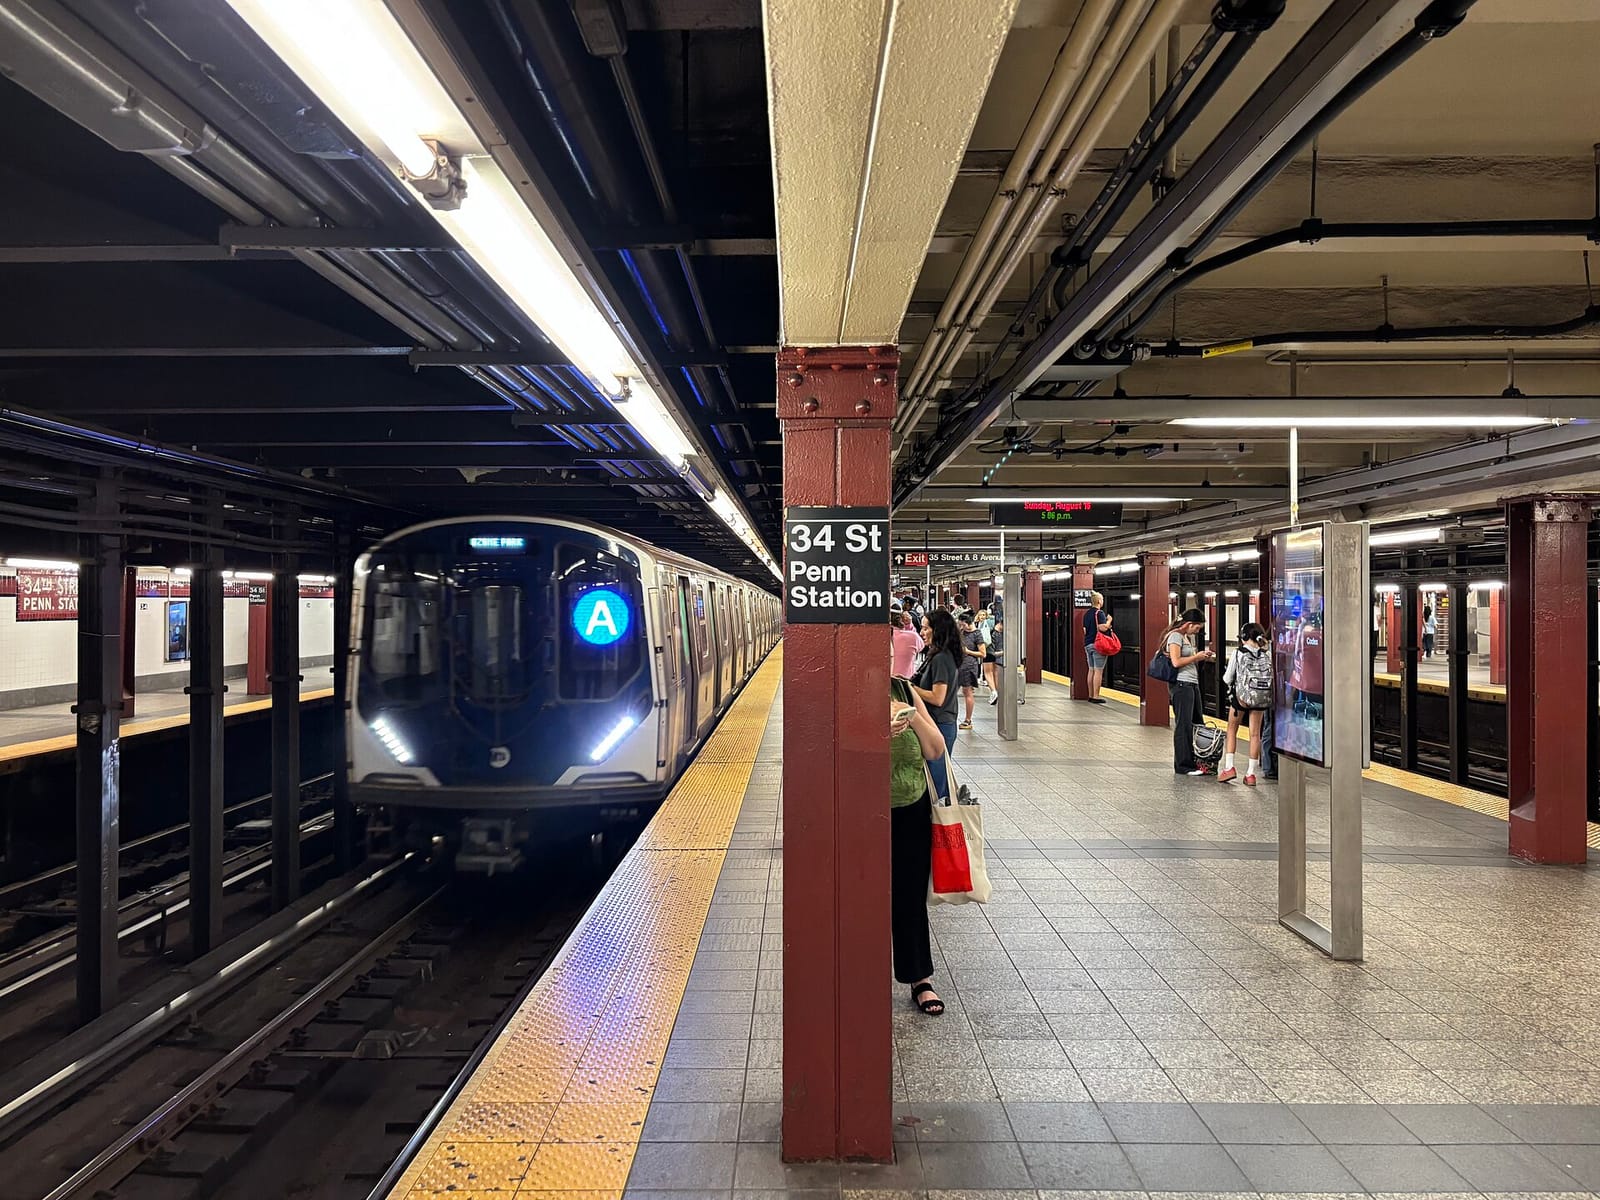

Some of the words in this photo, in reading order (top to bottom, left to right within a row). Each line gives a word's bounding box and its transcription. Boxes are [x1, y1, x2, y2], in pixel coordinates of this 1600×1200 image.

[1056, 501, 1082, 511] August
[790, 524, 836, 553] 34
[845, 524, 882, 553] St
[905, 553, 926, 563] Exit
[928, 553, 939, 561] 35
[941, 553, 963, 561] Street
[972, 553, 978, 561] 8
[980, 553, 1005, 561] Avenu
[790, 561, 851, 582] Penn
[57, 576, 78, 595] STR
[24, 597, 54, 611] PENN.
[790, 585, 882, 608] Station
[585, 599, 618, 636] A
